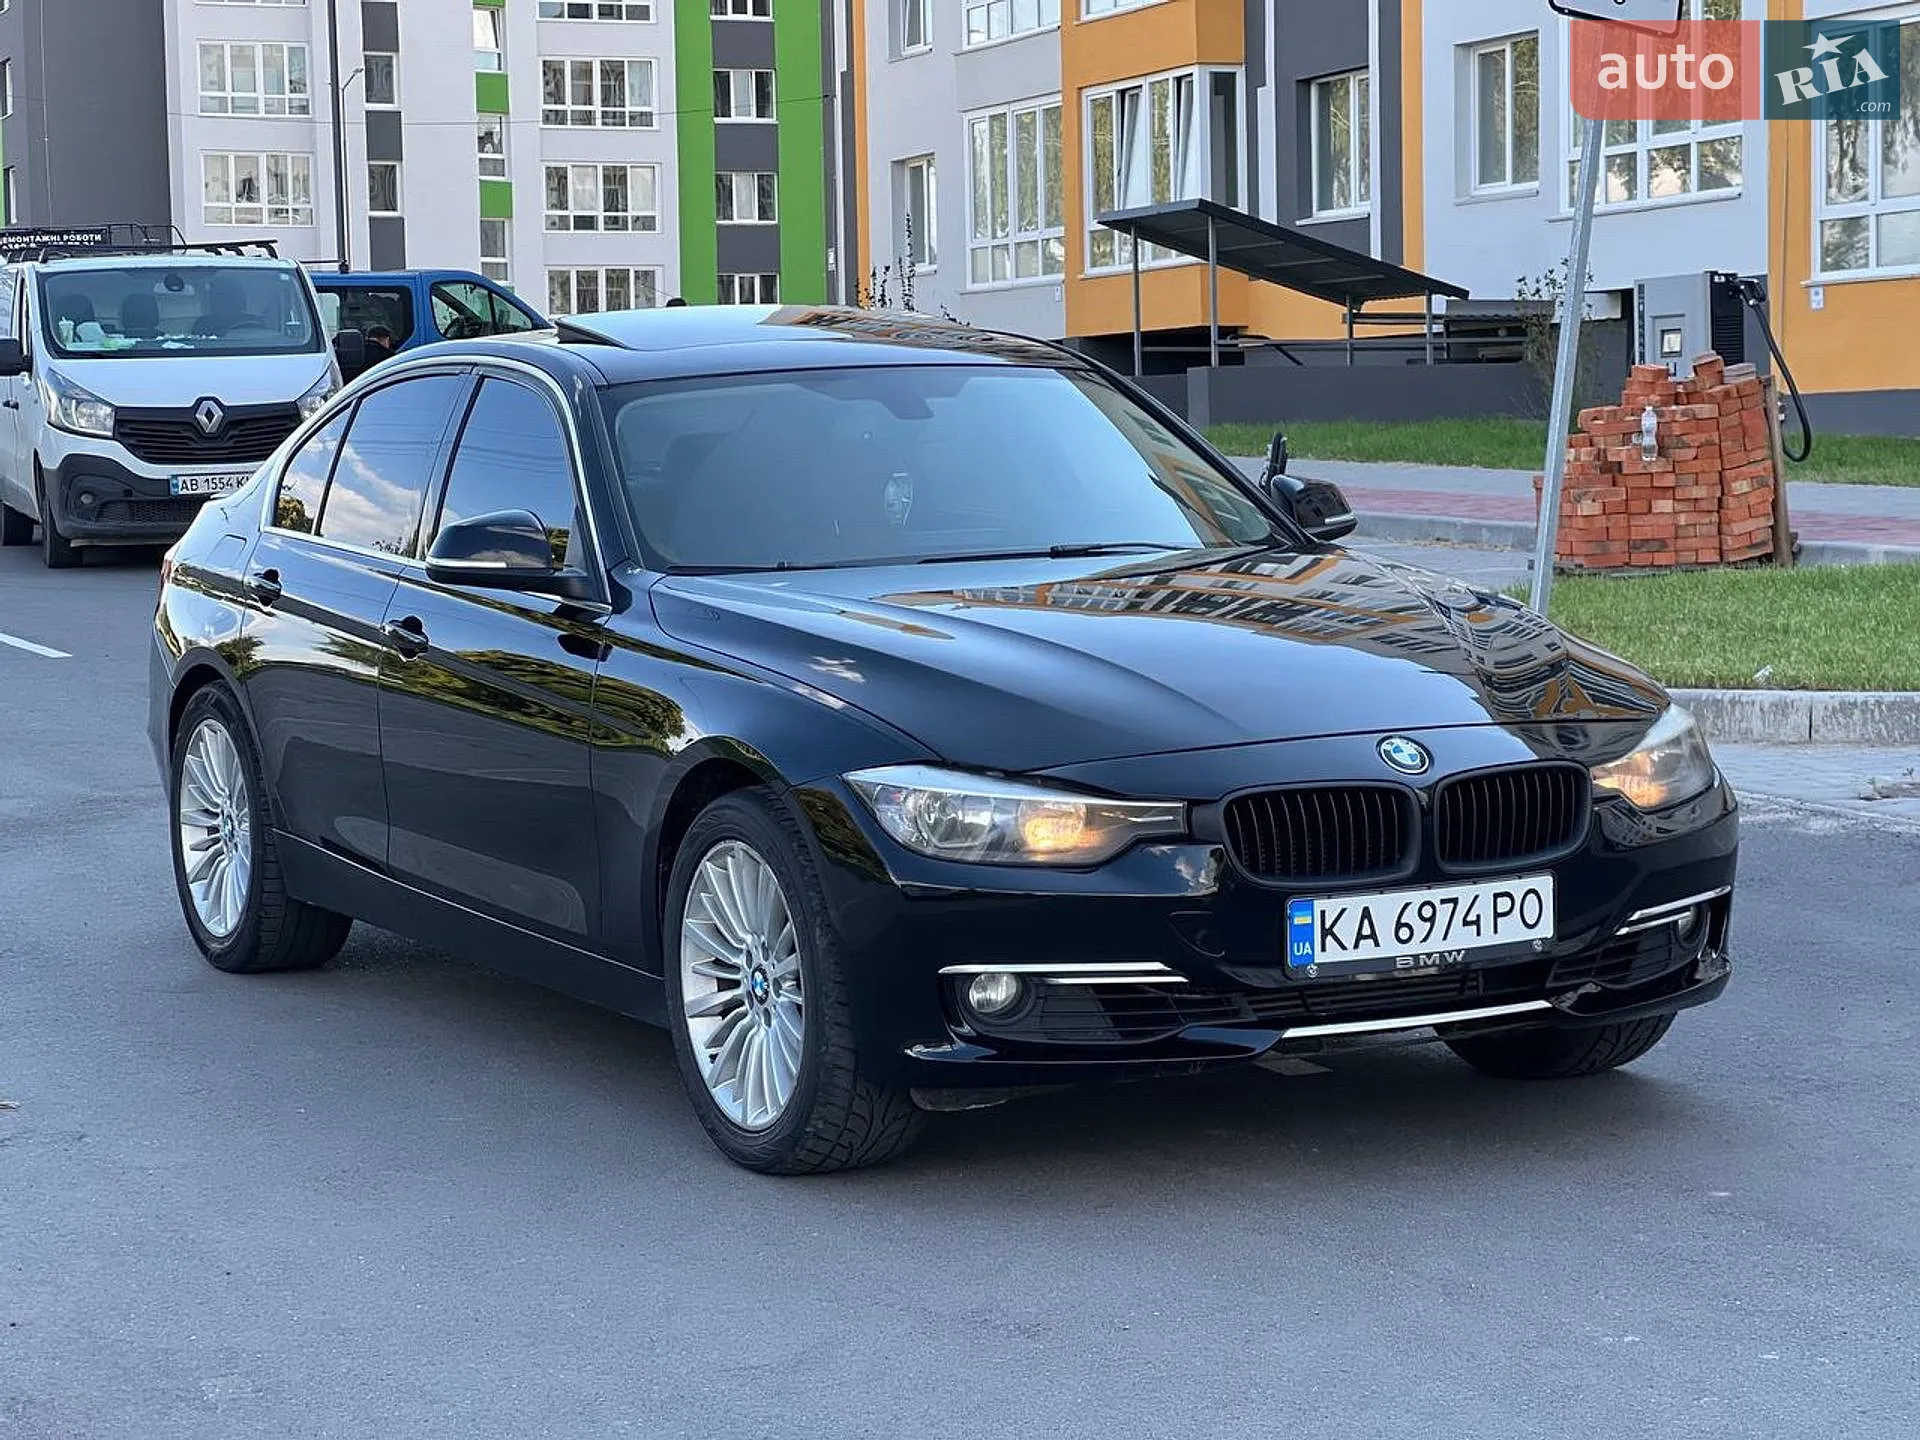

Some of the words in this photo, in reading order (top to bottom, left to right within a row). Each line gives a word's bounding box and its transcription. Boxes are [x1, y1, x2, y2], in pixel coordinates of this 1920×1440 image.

[0, 234, 60, 244] ЕМОНТАЖНІ
[180, 478, 199, 492] AB
[204, 477, 233, 492] 1554
[1319, 906, 1381, 952] KA
[1294, 943, 1312, 956] UA
[1396, 950, 1466, 968] BMW
